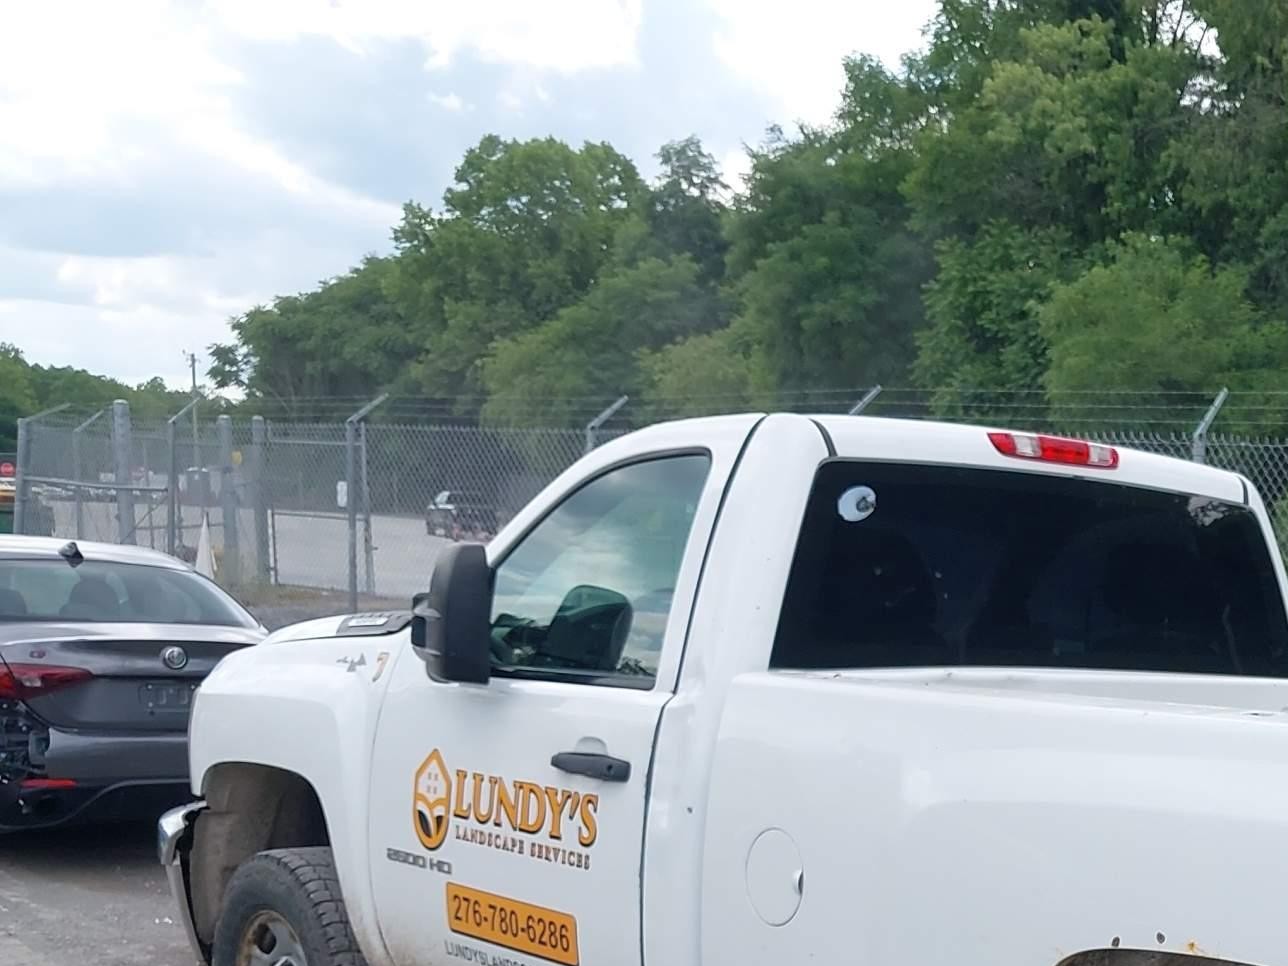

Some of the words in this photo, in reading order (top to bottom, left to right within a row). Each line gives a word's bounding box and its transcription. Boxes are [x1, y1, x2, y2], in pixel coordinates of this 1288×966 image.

[453, 769, 599, 848] LUNDY'S
[429, 857, 452, 875] HD
[455, 824, 525, 855] LANDSCAPE
[530, 842, 591, 871] SERVICES
[452, 895, 570, 952] 276-780-6286
